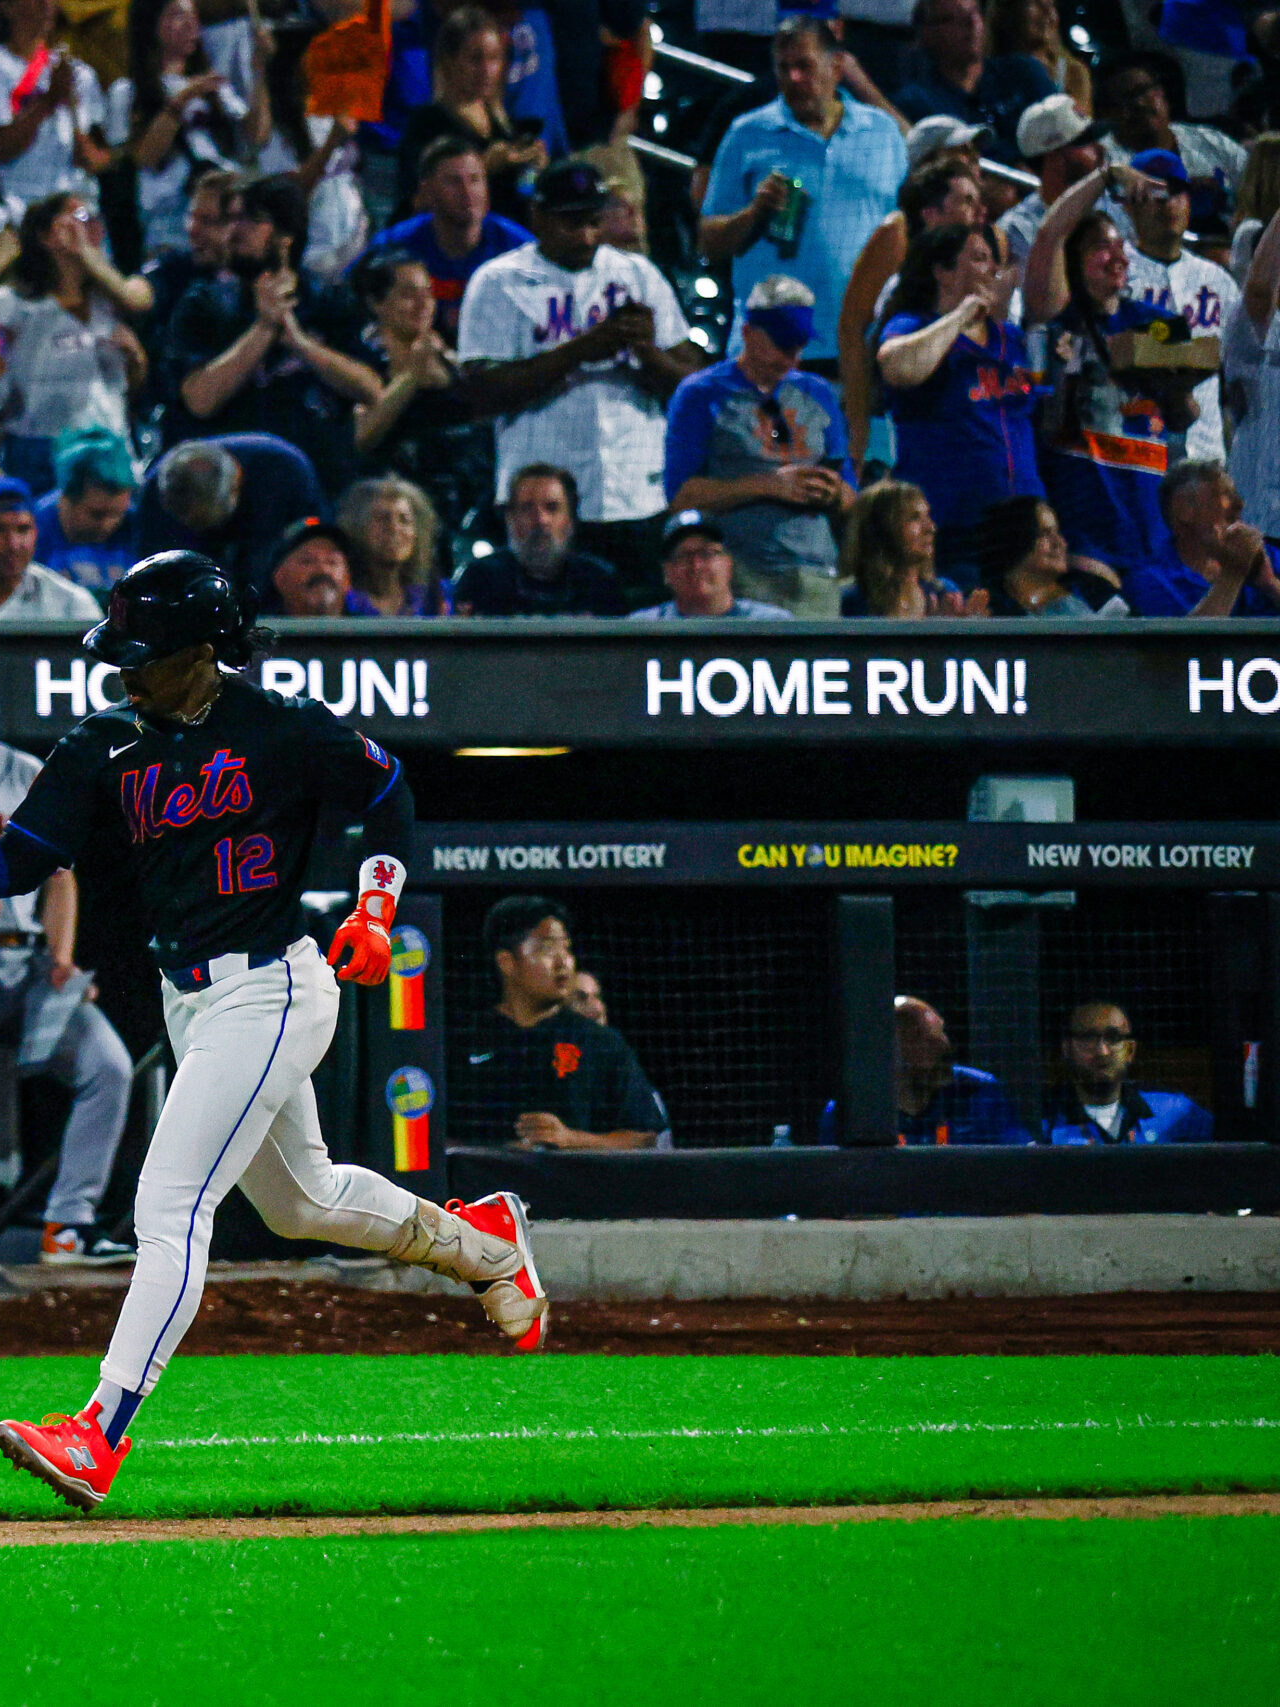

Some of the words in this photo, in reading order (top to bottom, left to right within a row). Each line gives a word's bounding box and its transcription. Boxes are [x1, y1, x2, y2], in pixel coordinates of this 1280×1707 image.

[261, 658, 429, 717] RUN!
[646, 657, 851, 716] HOME
[866, 658, 1027, 717] RUN!
[121, 748, 253, 844] Mets
[214, 833, 278, 895] 12
[433, 845, 489, 871] NEW
[494, 844, 561, 870] YORK
[566, 843, 667, 869] LOTTERY
[737, 843, 788, 868] CAN
[845, 843, 959, 868] IMAGINE?
[1027, 843, 1082, 867] NEW
[1086, 843, 1152, 868] YORK
[1159, 845, 1255, 868] LOTTERY
